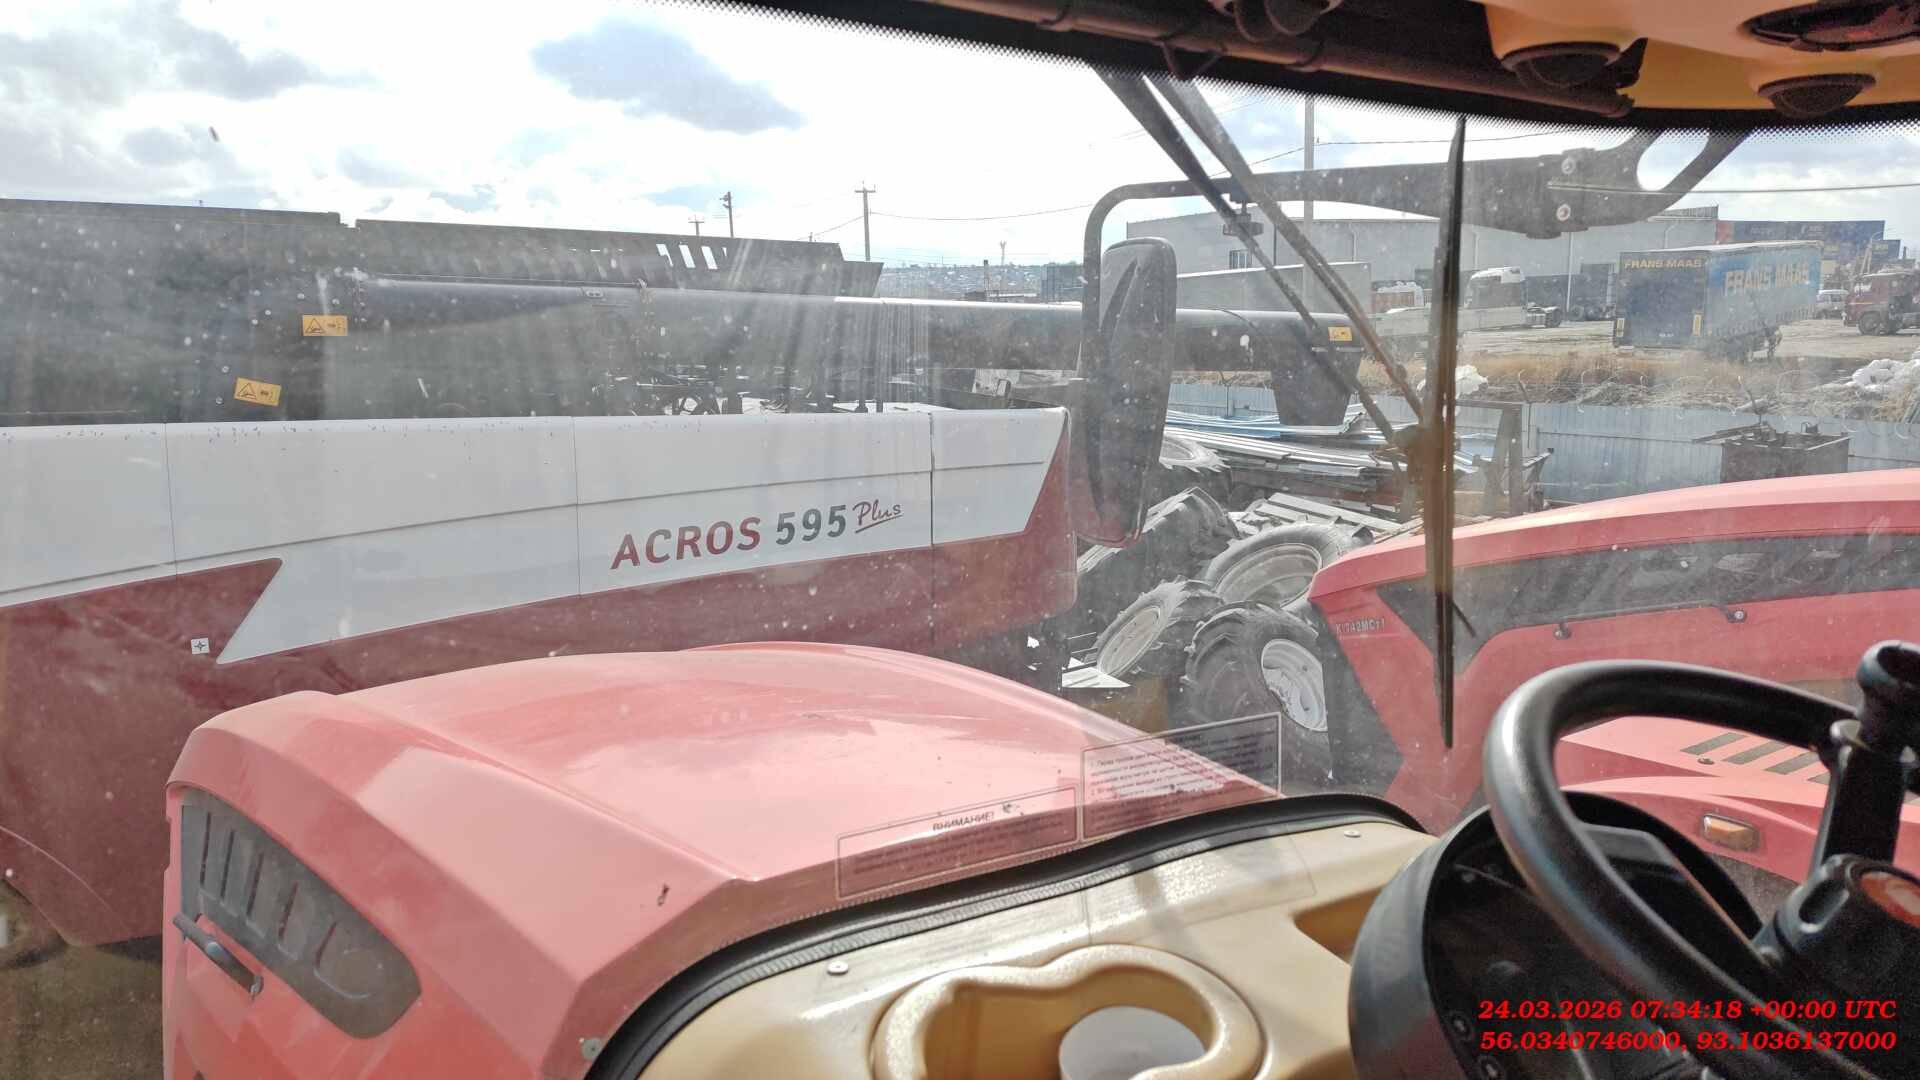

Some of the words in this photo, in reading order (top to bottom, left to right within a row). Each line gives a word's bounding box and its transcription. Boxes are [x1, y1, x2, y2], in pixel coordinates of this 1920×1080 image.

[1624, 259, 1664, 269] FRANS
[1667, 258, 1702, 268] MAAS
[610, 516, 761, 570] ACROS
[775, 504, 847, 545] 595
[853, 499, 903, 530] Plus
